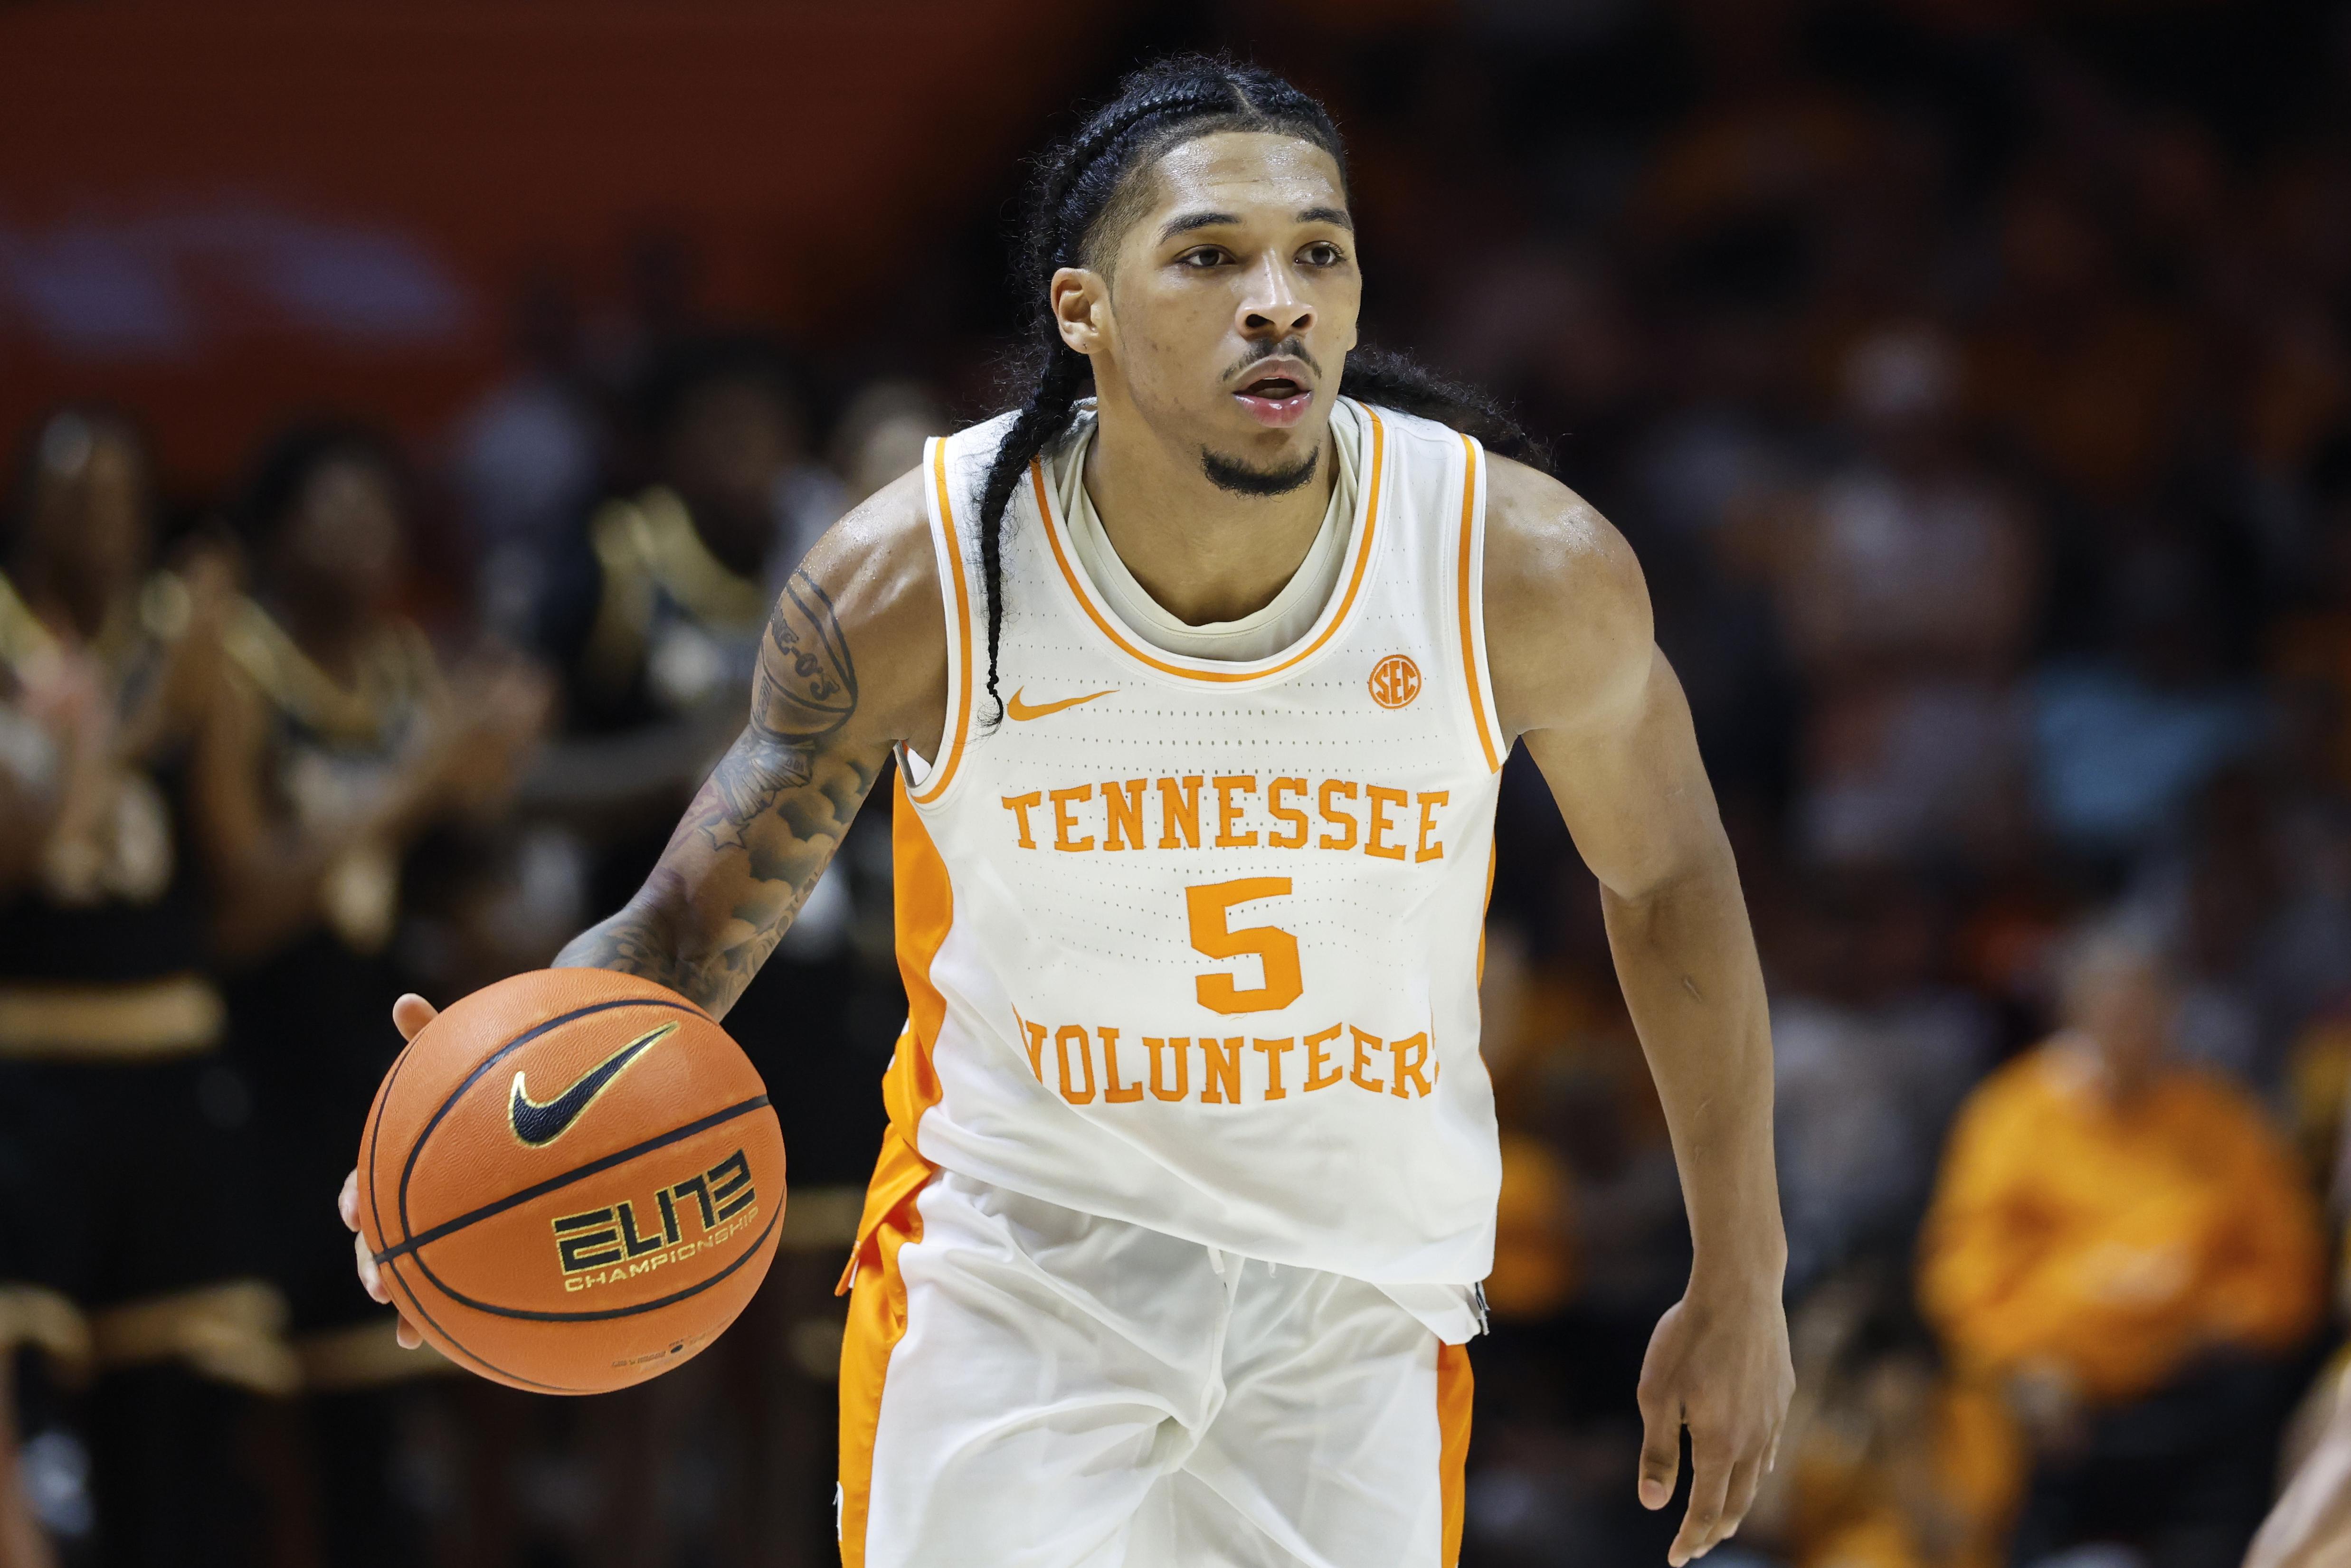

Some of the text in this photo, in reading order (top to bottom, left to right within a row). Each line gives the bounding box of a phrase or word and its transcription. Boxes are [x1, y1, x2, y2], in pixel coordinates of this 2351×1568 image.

[1375, 661, 1416, 704] SEC
[1002, 775, 1449, 863] TENNESSEE
[1185, 877, 1304, 1015] 5
[1011, 1001, 1440, 1105] VOLUNTEER
[551, 1148, 757, 1275] ELITE
[565, 1206, 759, 1292] CHAMPIONSHIP
